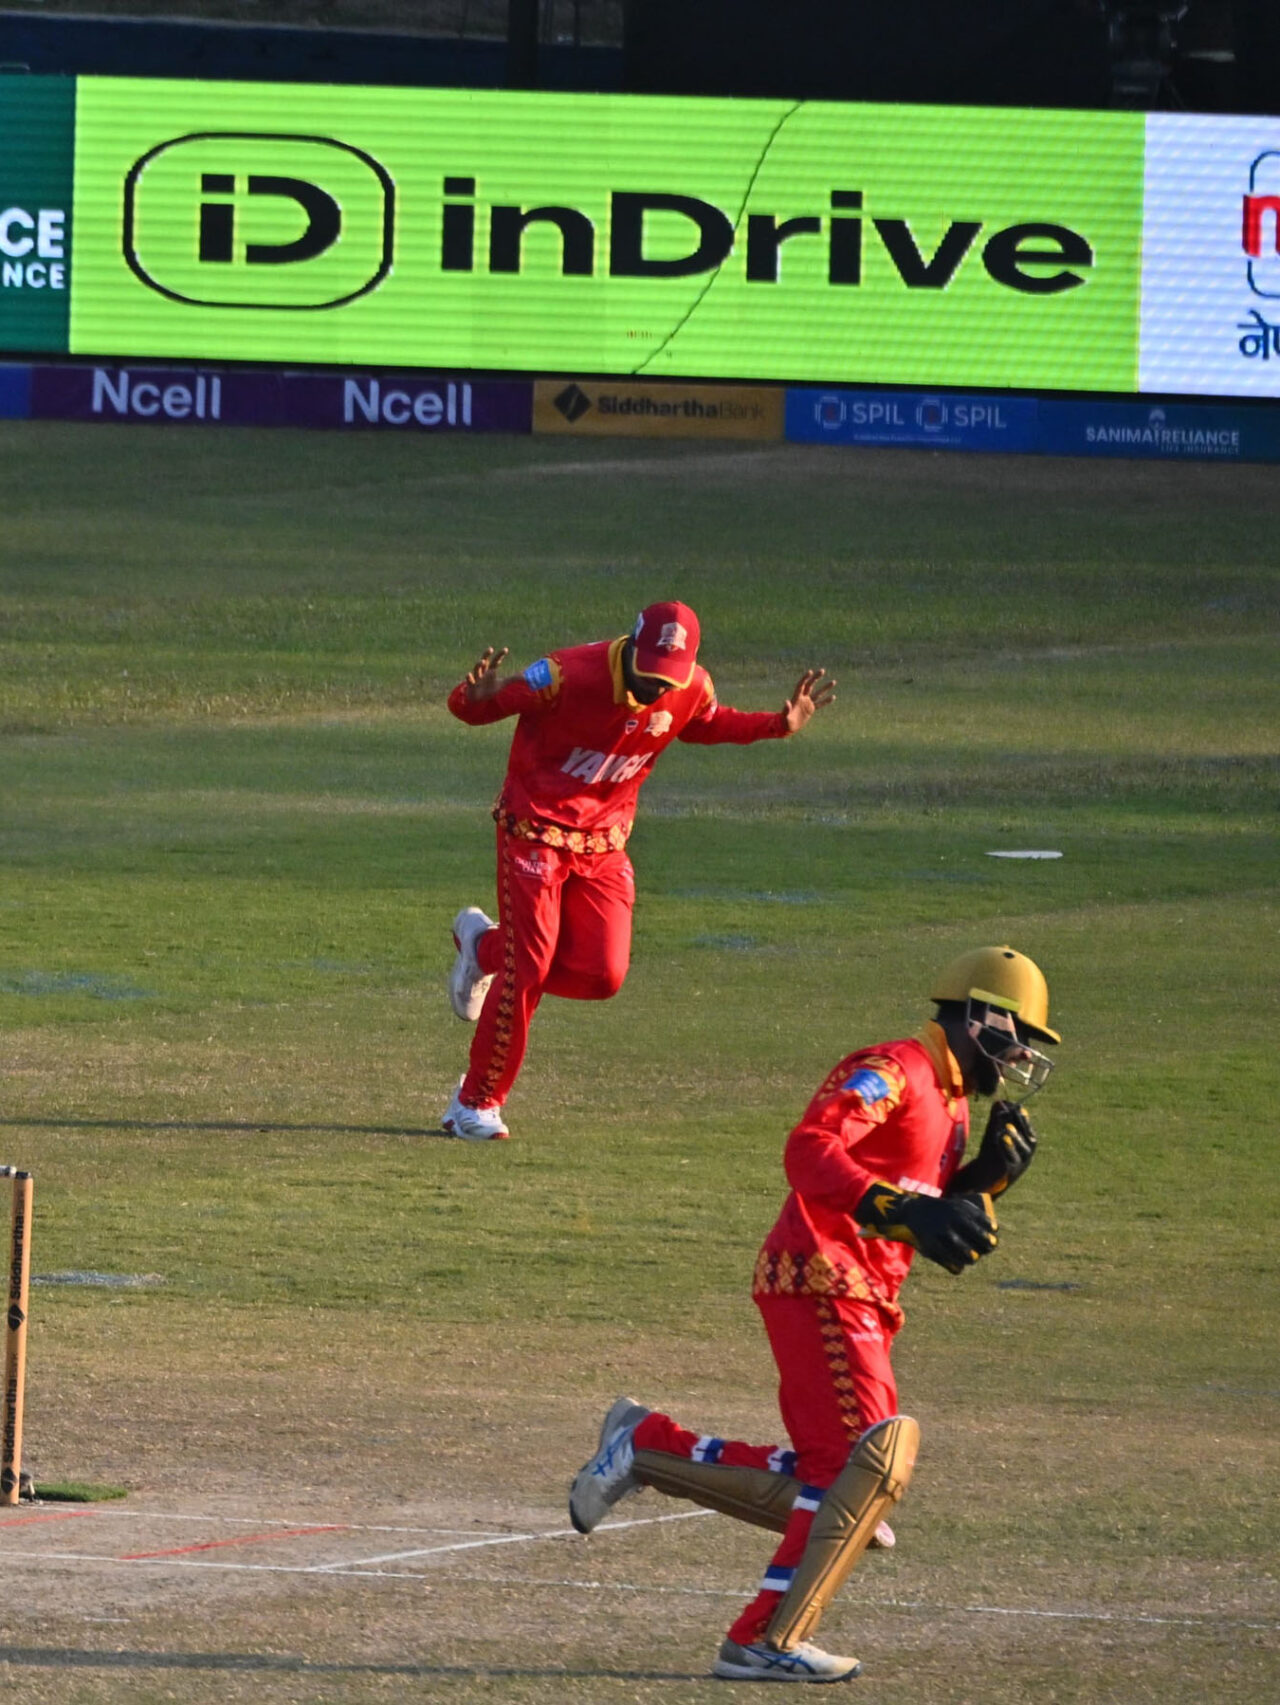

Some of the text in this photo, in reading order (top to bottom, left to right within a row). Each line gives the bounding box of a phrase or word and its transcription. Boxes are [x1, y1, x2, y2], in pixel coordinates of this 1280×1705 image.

[440, 176, 1095, 295] inDrive
[91, 367, 221, 419] Ncell
[342, 378, 473, 426] Ncell
[852, 402, 1008, 429] SPIL SPIL
[1085, 426, 1240, 446] SANIMA RELIANCE
[10, 1215, 24, 1300] Siddhartha
[4, 1378, 18, 1463] Siddhartha
